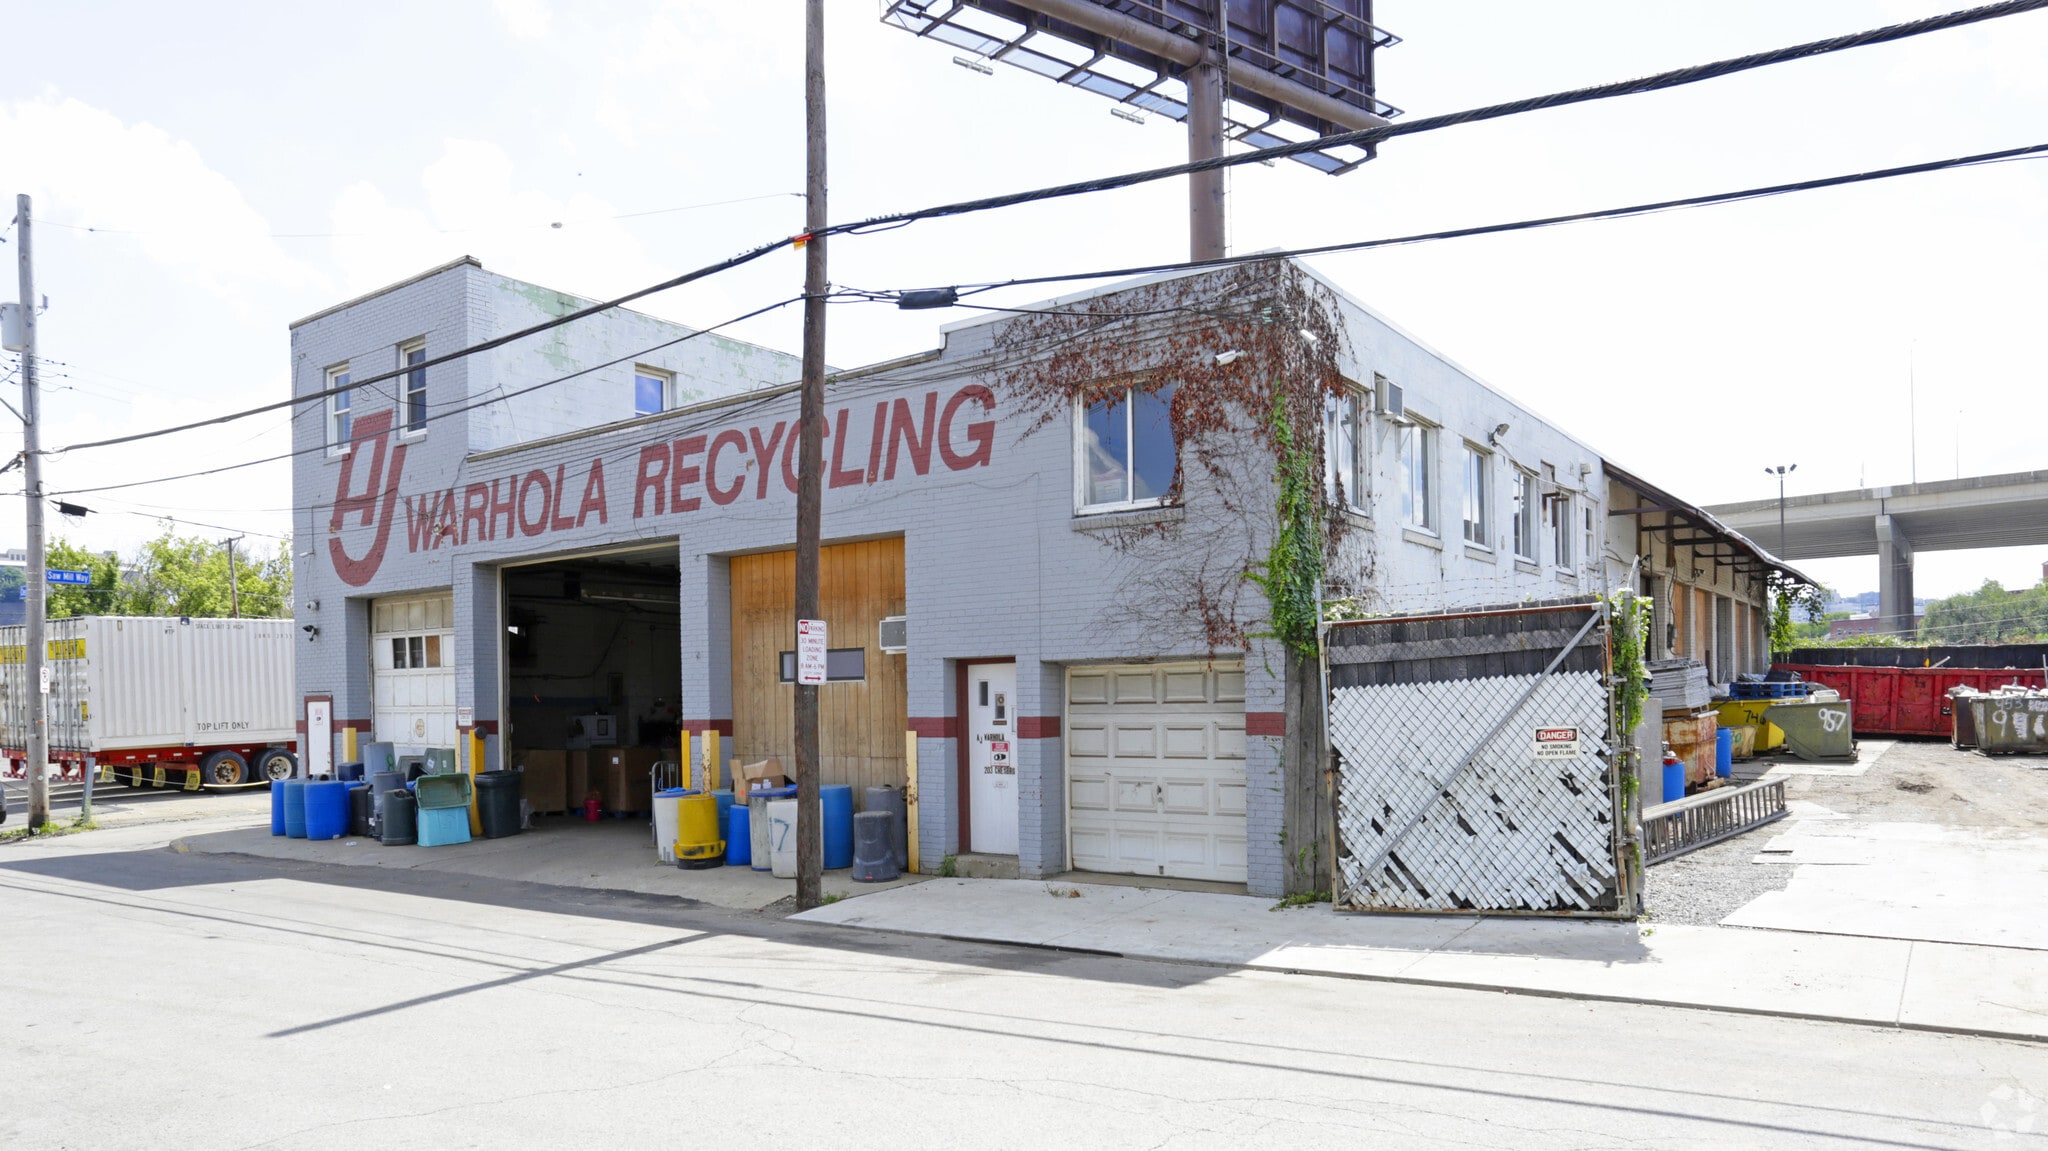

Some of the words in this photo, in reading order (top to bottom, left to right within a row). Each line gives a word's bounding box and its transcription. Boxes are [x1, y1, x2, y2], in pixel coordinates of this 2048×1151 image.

[405, 457, 608, 553] WARHOLA
[633, 384, 996, 518] RECYCLING
[47, 571, 61, 580] Saw
[63, 572, 74, 581] Mill
[76, 574, 89, 584] Way
[800, 622, 808, 633] NO
[197, 723, 212, 731] TOP
[213, 722, 229, 731] LIFT
[231, 721, 250, 730] ONLY
[1818, 708, 1847, 732] 957
[1540, 731, 1574, 740] DANGER
